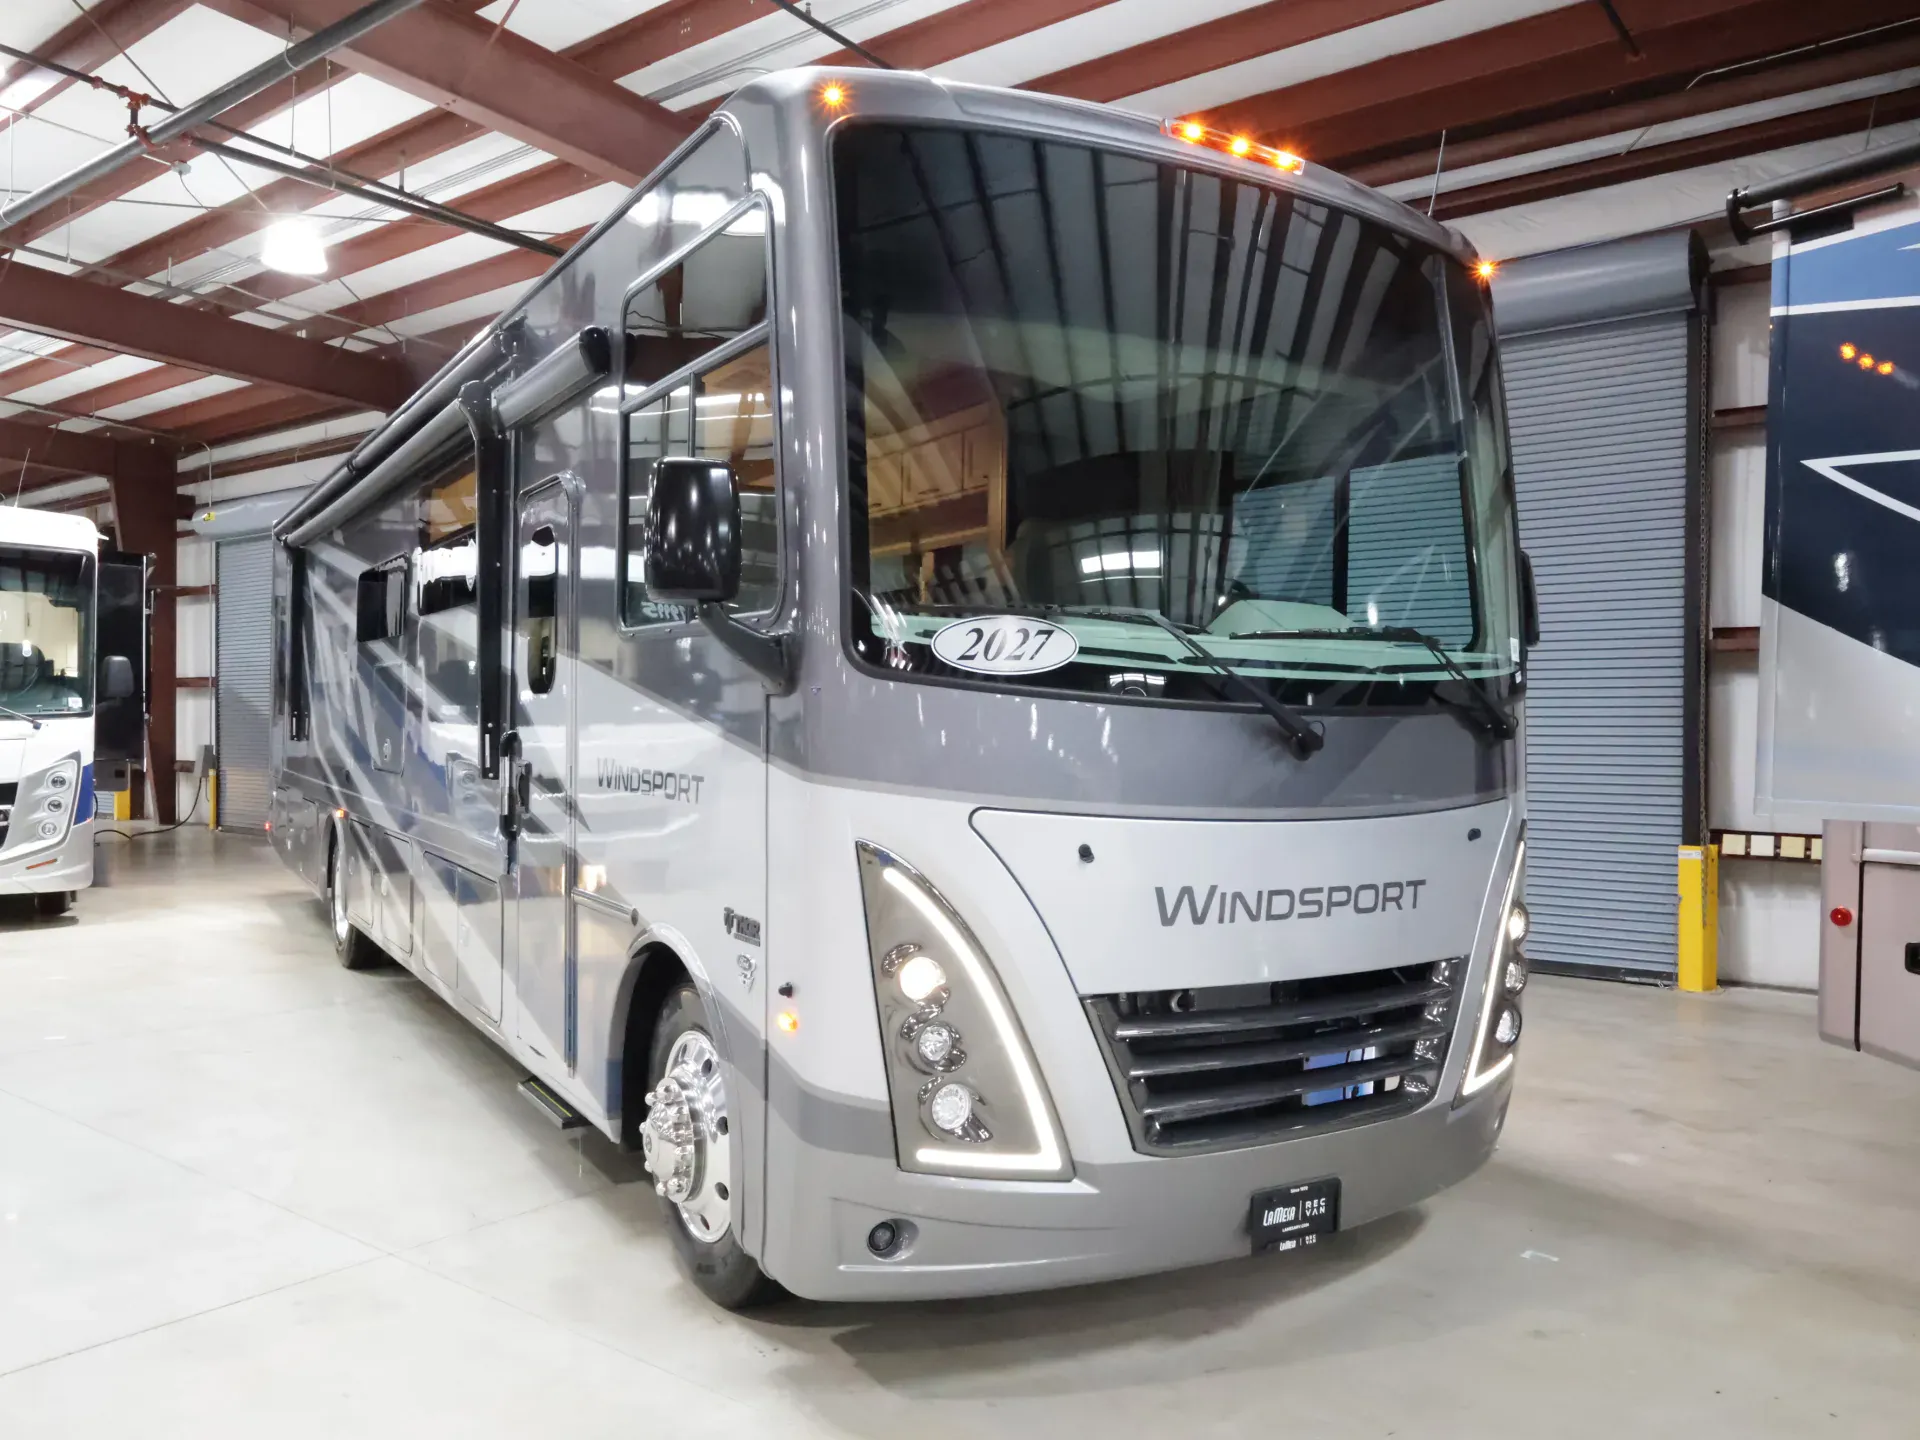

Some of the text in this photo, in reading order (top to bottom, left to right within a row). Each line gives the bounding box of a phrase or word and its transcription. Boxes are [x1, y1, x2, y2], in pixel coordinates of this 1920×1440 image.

[956, 627, 1055, 661] 2027
[597, 757, 705, 804] WINDSPORT
[1154, 879, 1427, 927] WINDSPORT
[1263, 1206, 1296, 1227] LAMESA
[1305, 1198, 1326, 1209] REC
[1305, 1206, 1326, 1217] VAN
